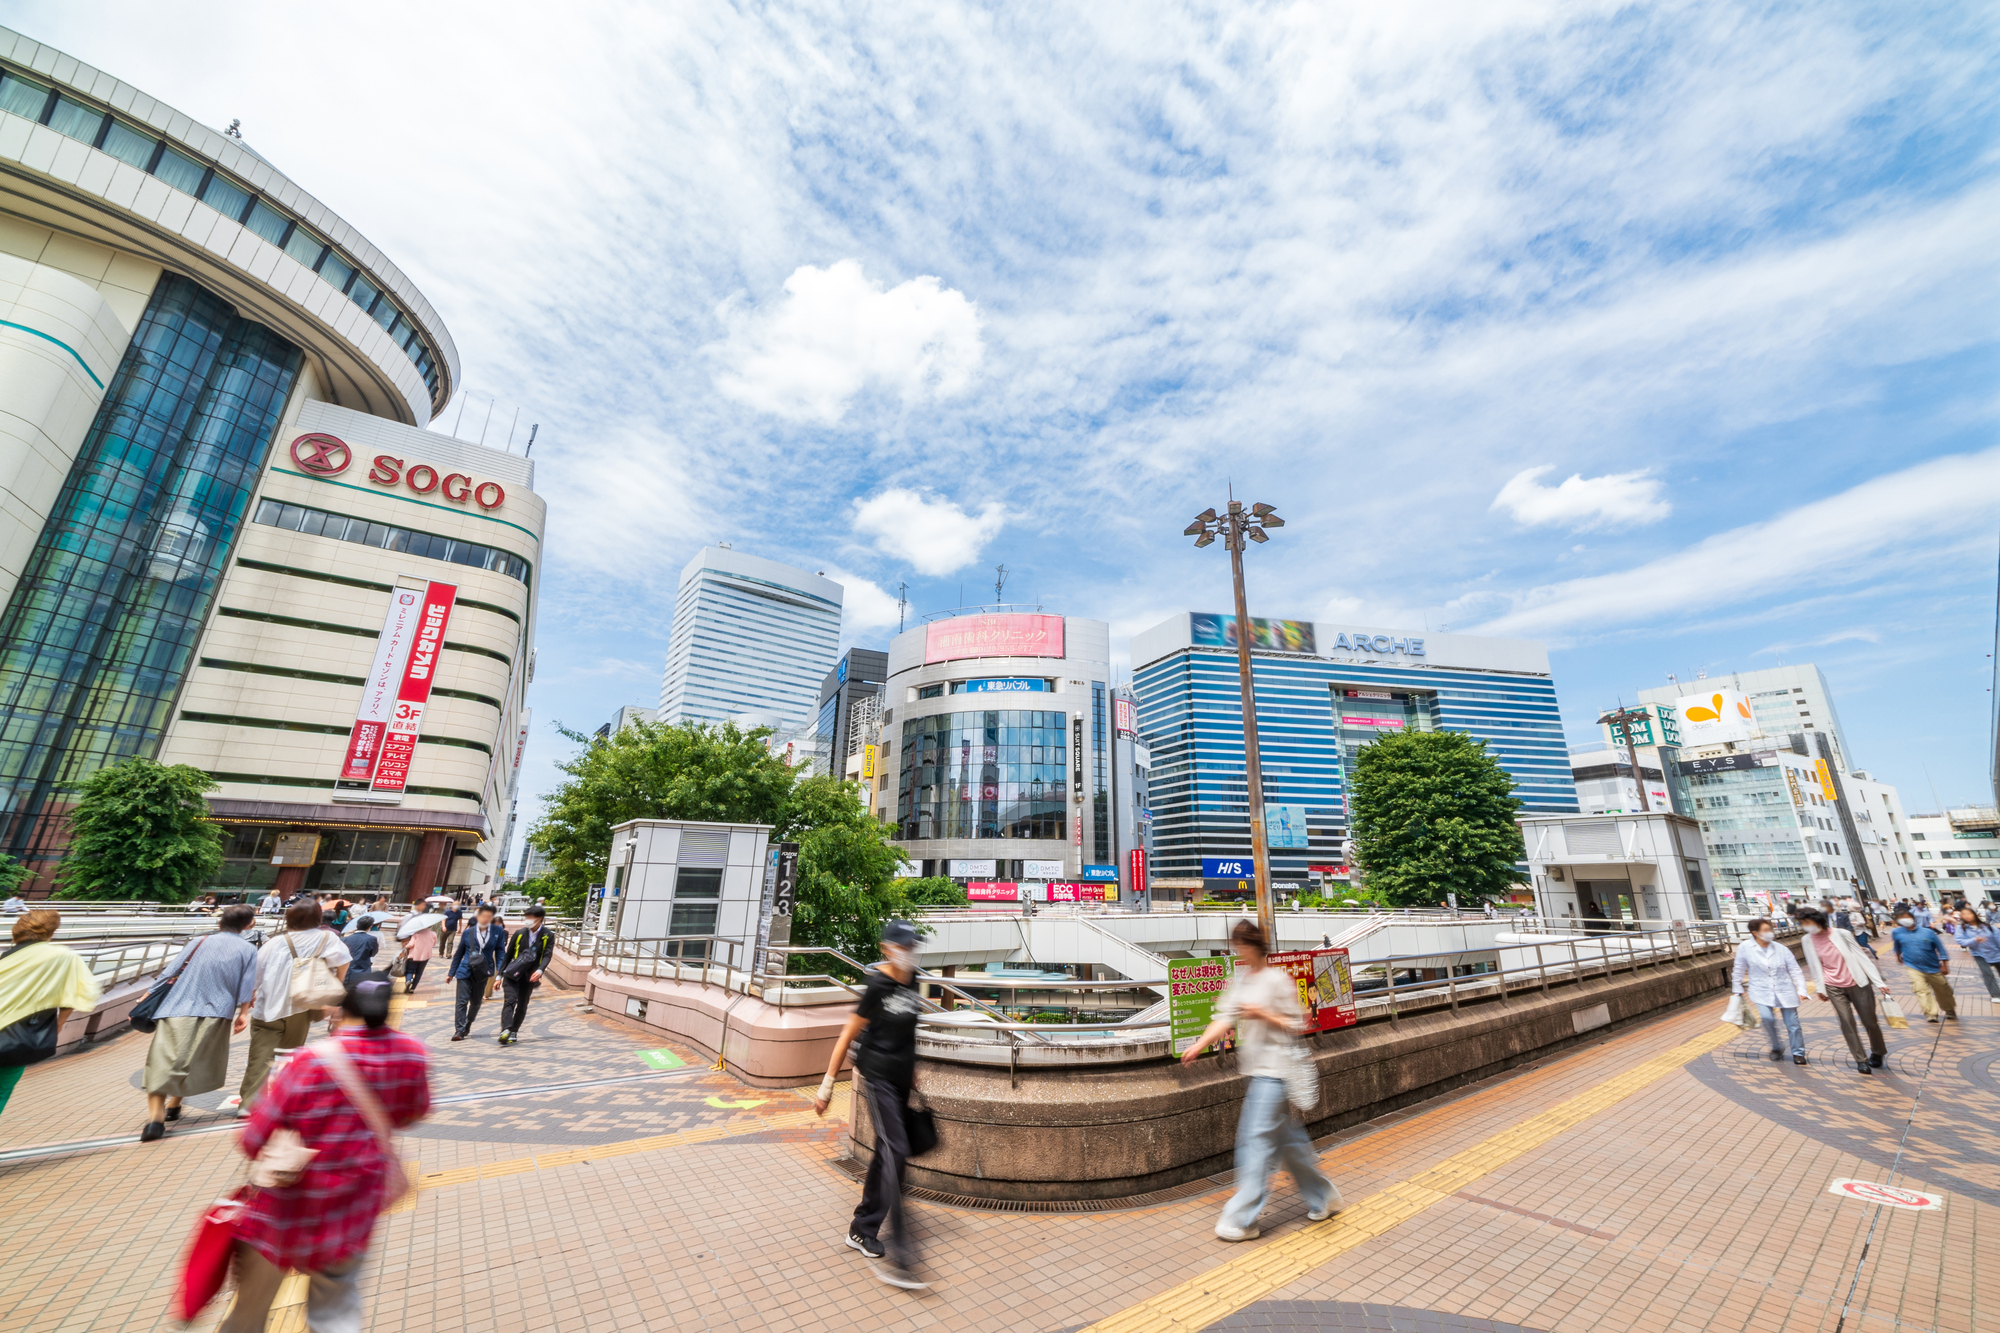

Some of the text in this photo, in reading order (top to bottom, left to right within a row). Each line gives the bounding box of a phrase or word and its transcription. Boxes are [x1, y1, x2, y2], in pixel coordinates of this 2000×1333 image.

[368, 455, 505, 511] SOGO
[409, 604, 446, 680] ビックカメラ
[1332, 632, 1426, 656] ARCHE
[987, 681, 1031, 691] 東急リバブル
[395, 704, 421, 721] 3F
[392, 721, 418, 732] 直結
[393, 734, 410, 742] 家電
[385, 743, 412, 751] エアコン
[1692, 757, 1735, 769] EYS
[381, 769, 402, 777] スマホ
[782, 860, 792, 877] 1
[591, 891, 599, 899] 4
[779, 880, 792, 897] 2
[1053, 884, 1074, 893] ECC
[777, 899, 790, 918] 3
[1171, 965, 1224, 980] なぜ人は現状を
